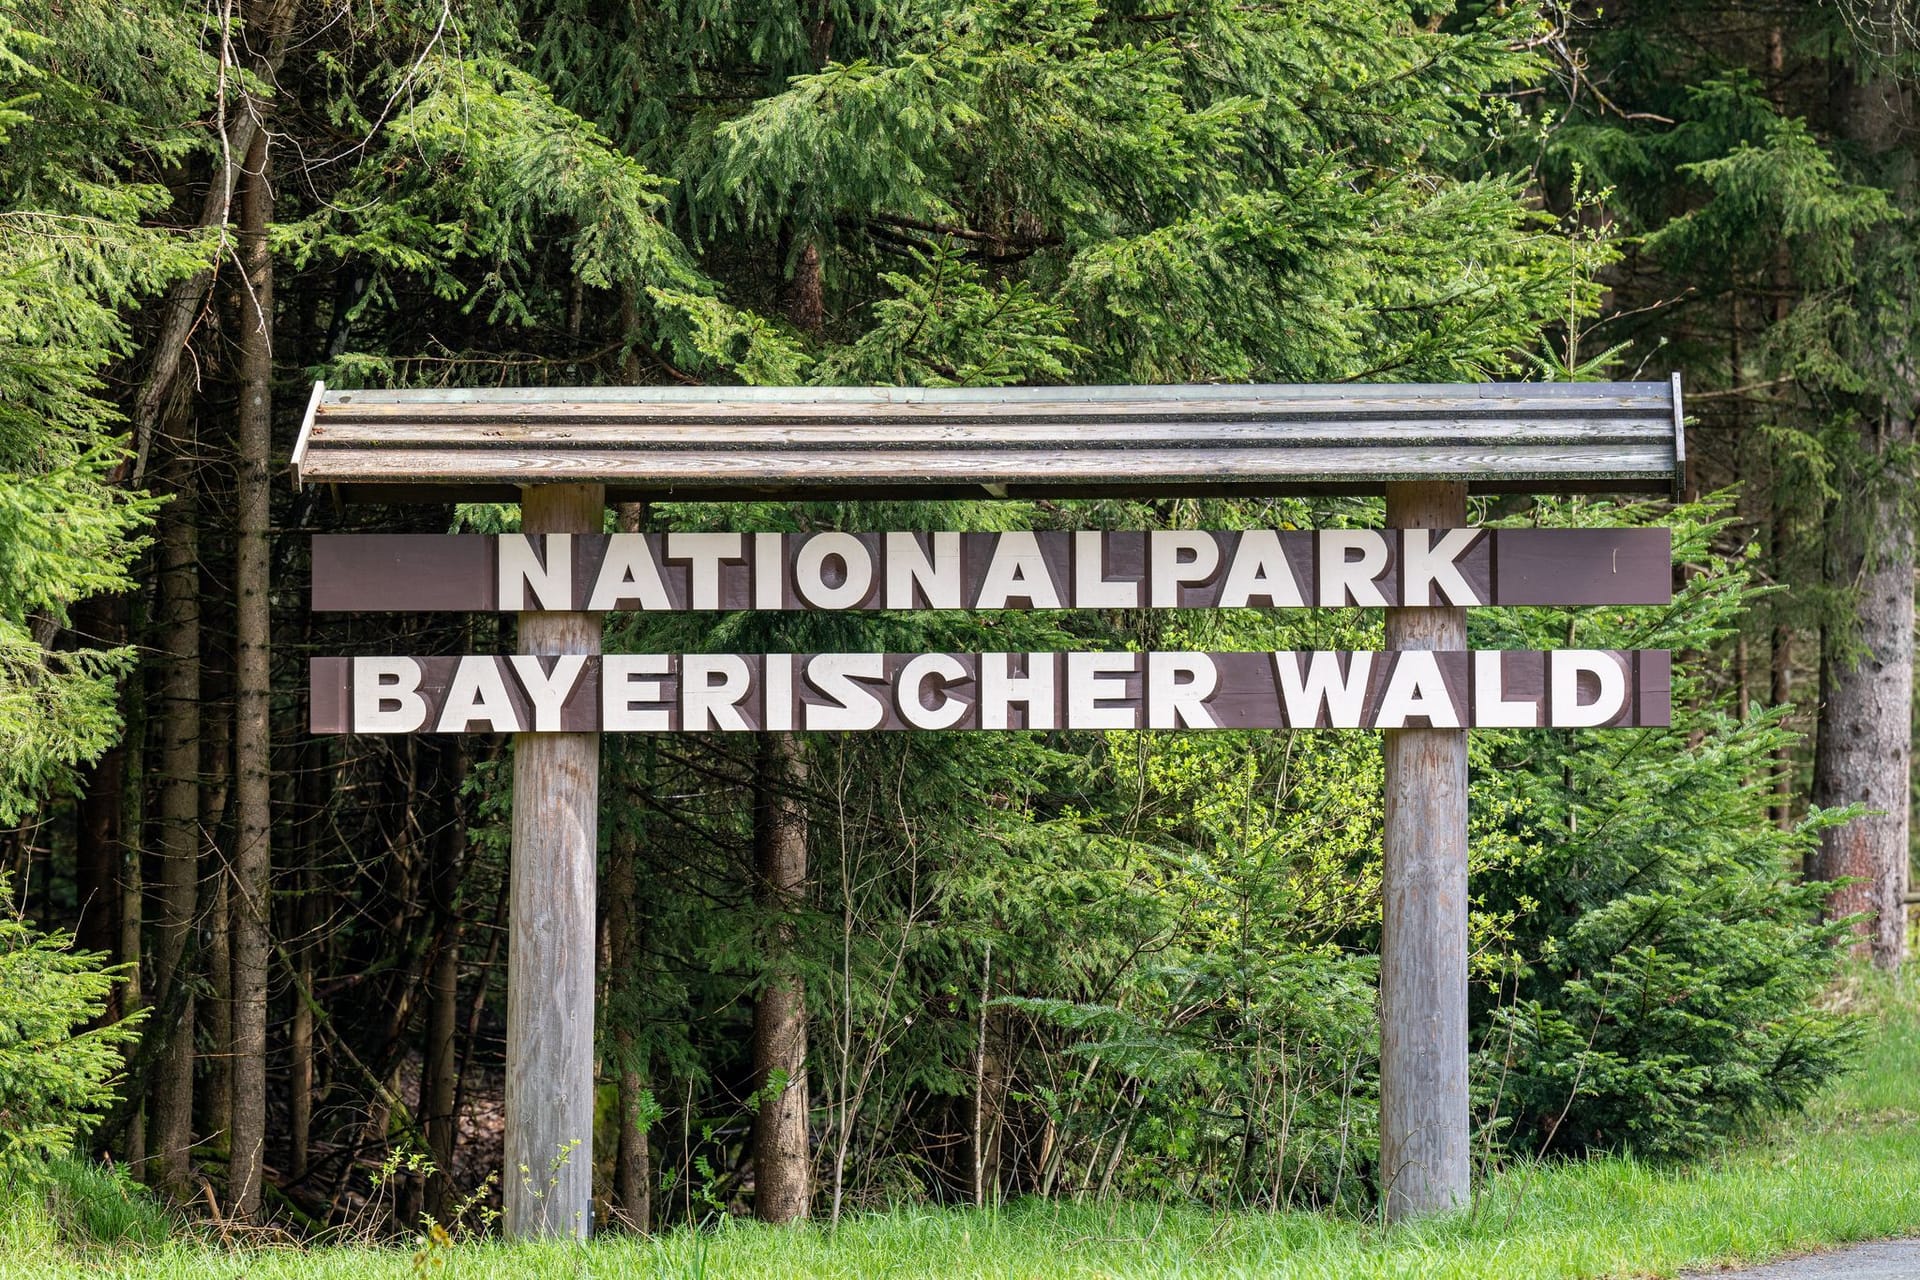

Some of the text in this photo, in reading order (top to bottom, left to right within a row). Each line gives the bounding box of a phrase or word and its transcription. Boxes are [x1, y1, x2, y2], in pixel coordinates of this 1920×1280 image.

[498, 529, 1482, 611] NATIONALPARK
[353, 650, 1626, 733] BAYERISCHER WALD
